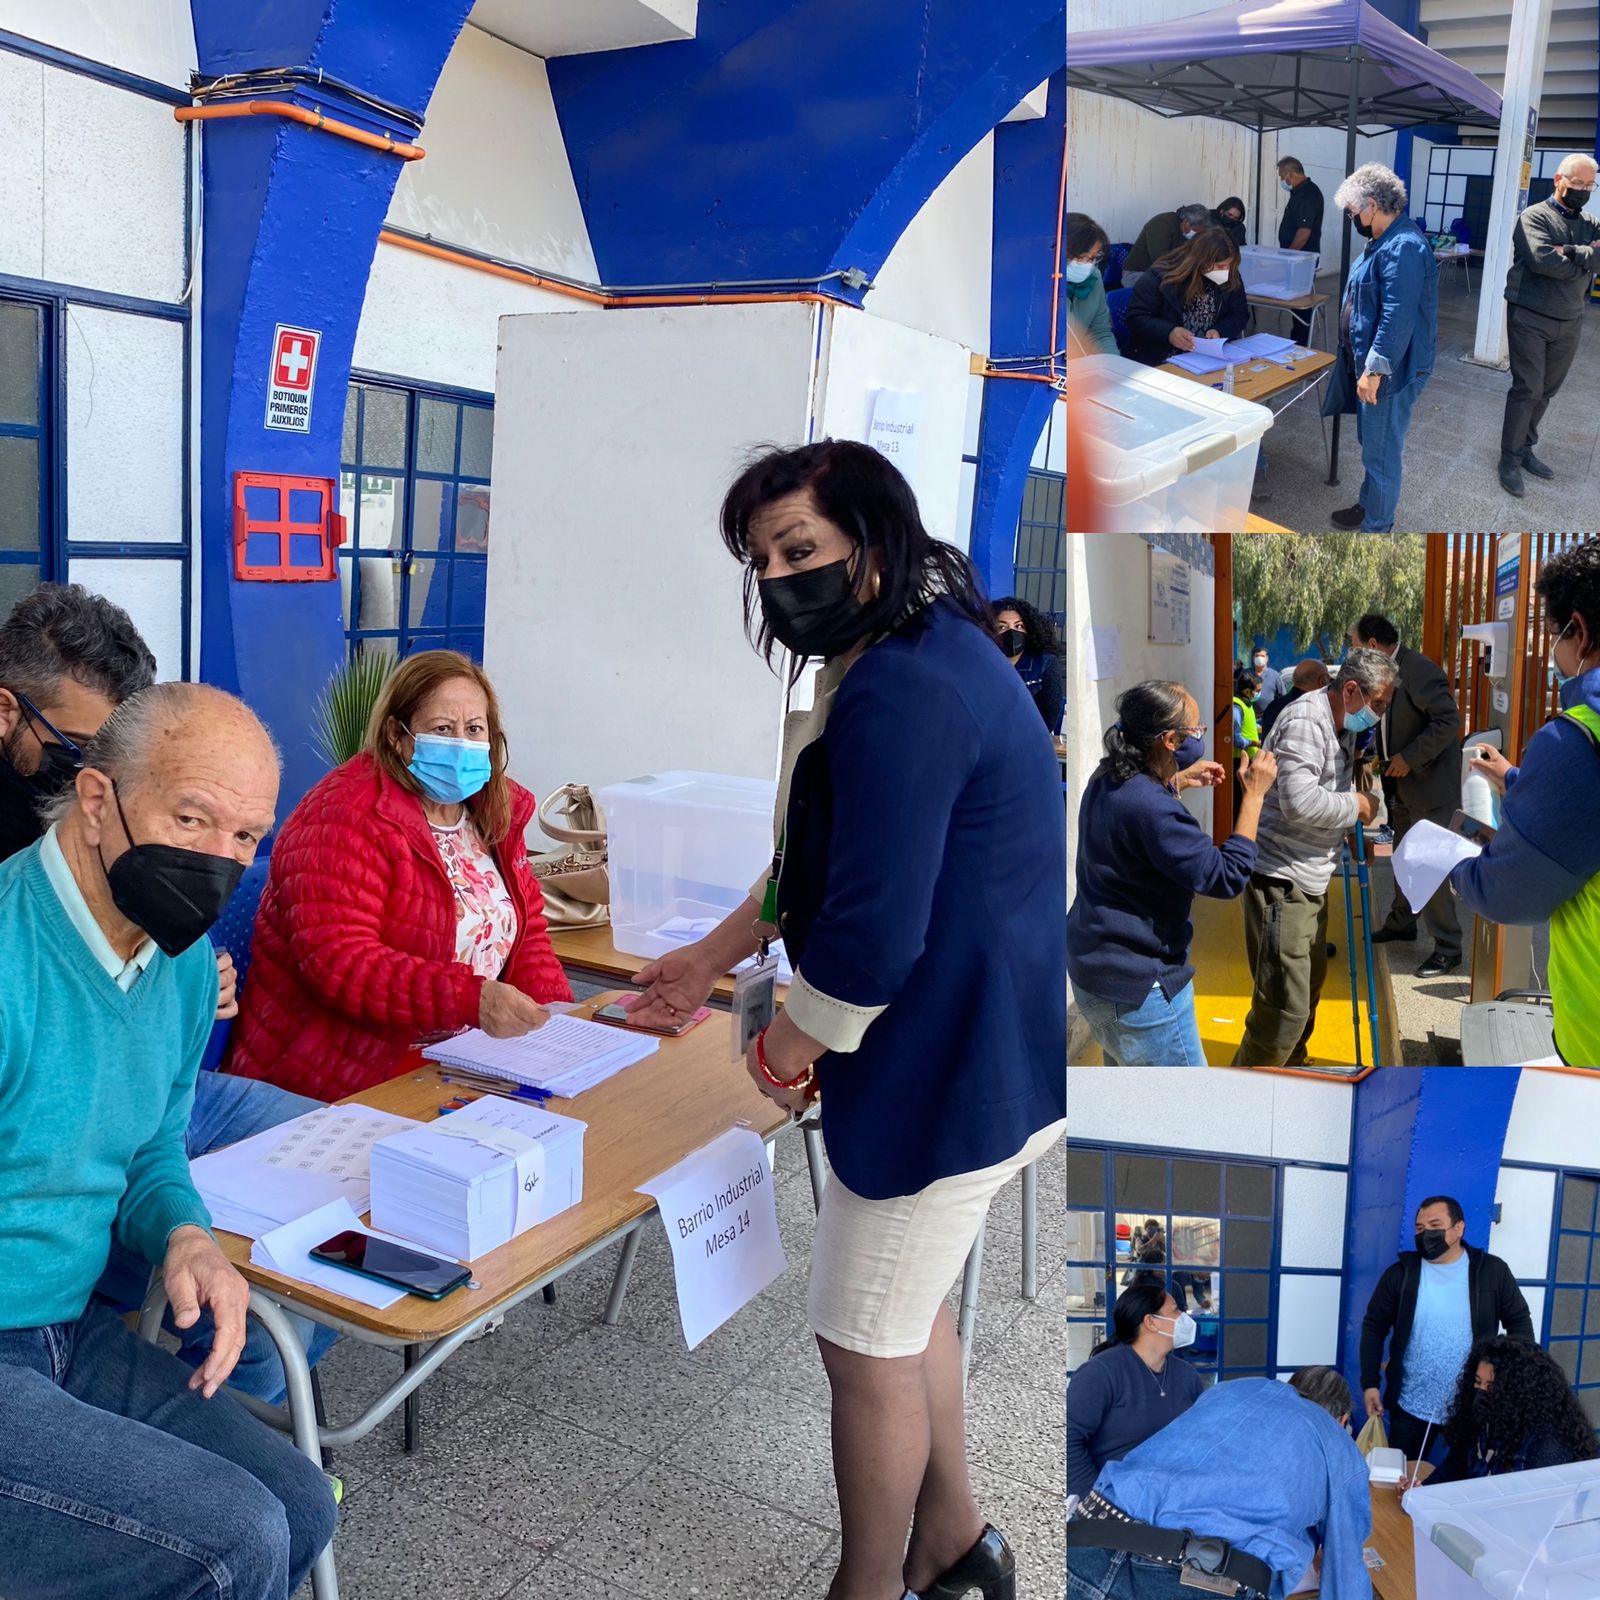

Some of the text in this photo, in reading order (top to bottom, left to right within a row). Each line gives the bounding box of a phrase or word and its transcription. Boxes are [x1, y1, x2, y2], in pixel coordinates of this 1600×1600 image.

[273, 390, 308, 404] BOTIQUIN
[270, 402, 308, 416] PRIMEROS
[271, 414, 305, 427] AUXILIOS
[891, 441, 899, 453] 13
[677, 1162, 764, 1239] Barrio Industrial
[705, 1209, 751, 1258] Mesa 14
